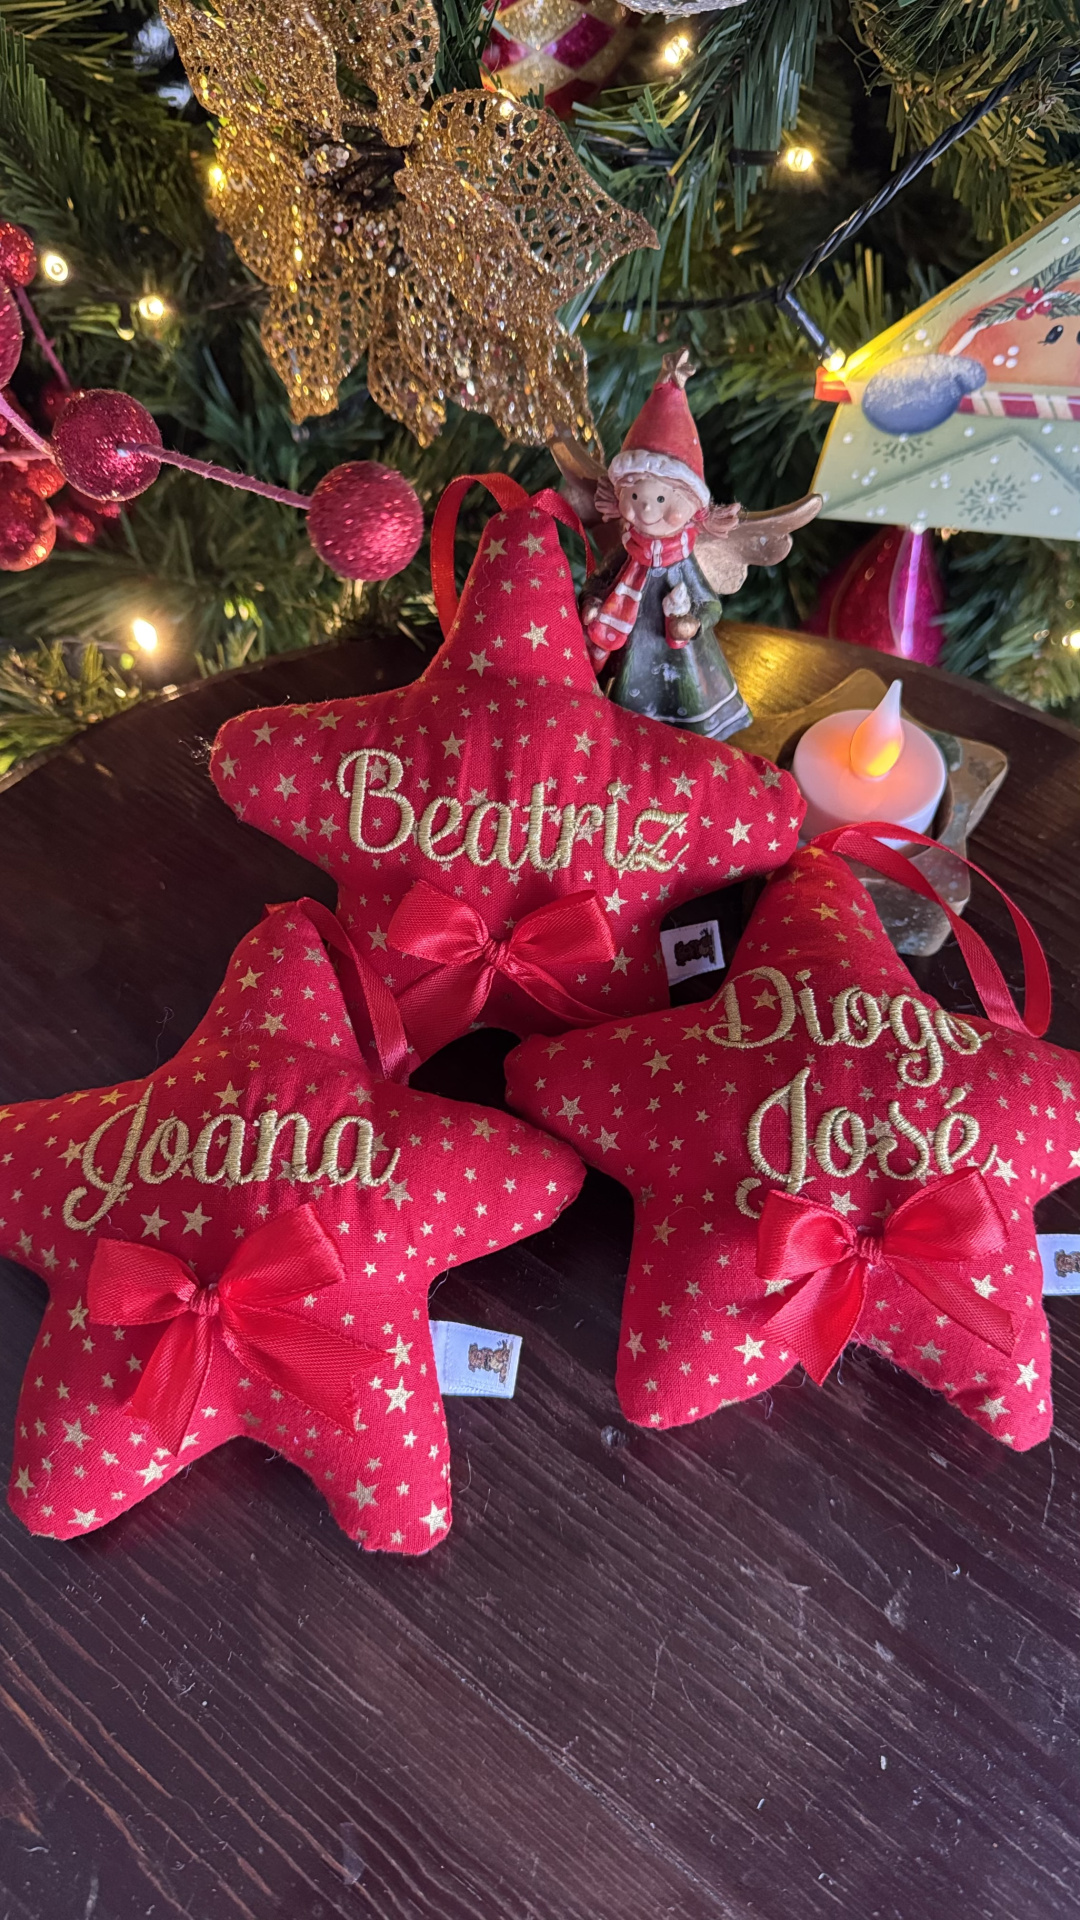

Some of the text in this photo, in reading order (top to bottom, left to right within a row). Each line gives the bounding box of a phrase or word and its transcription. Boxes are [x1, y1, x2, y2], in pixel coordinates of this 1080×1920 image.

[335, 747, 690, 873] Beatriz
[705, 965, 992, 1088] Diogo
[62, 1082, 402, 1231] Joana
[734, 1066, 998, 1220] José
